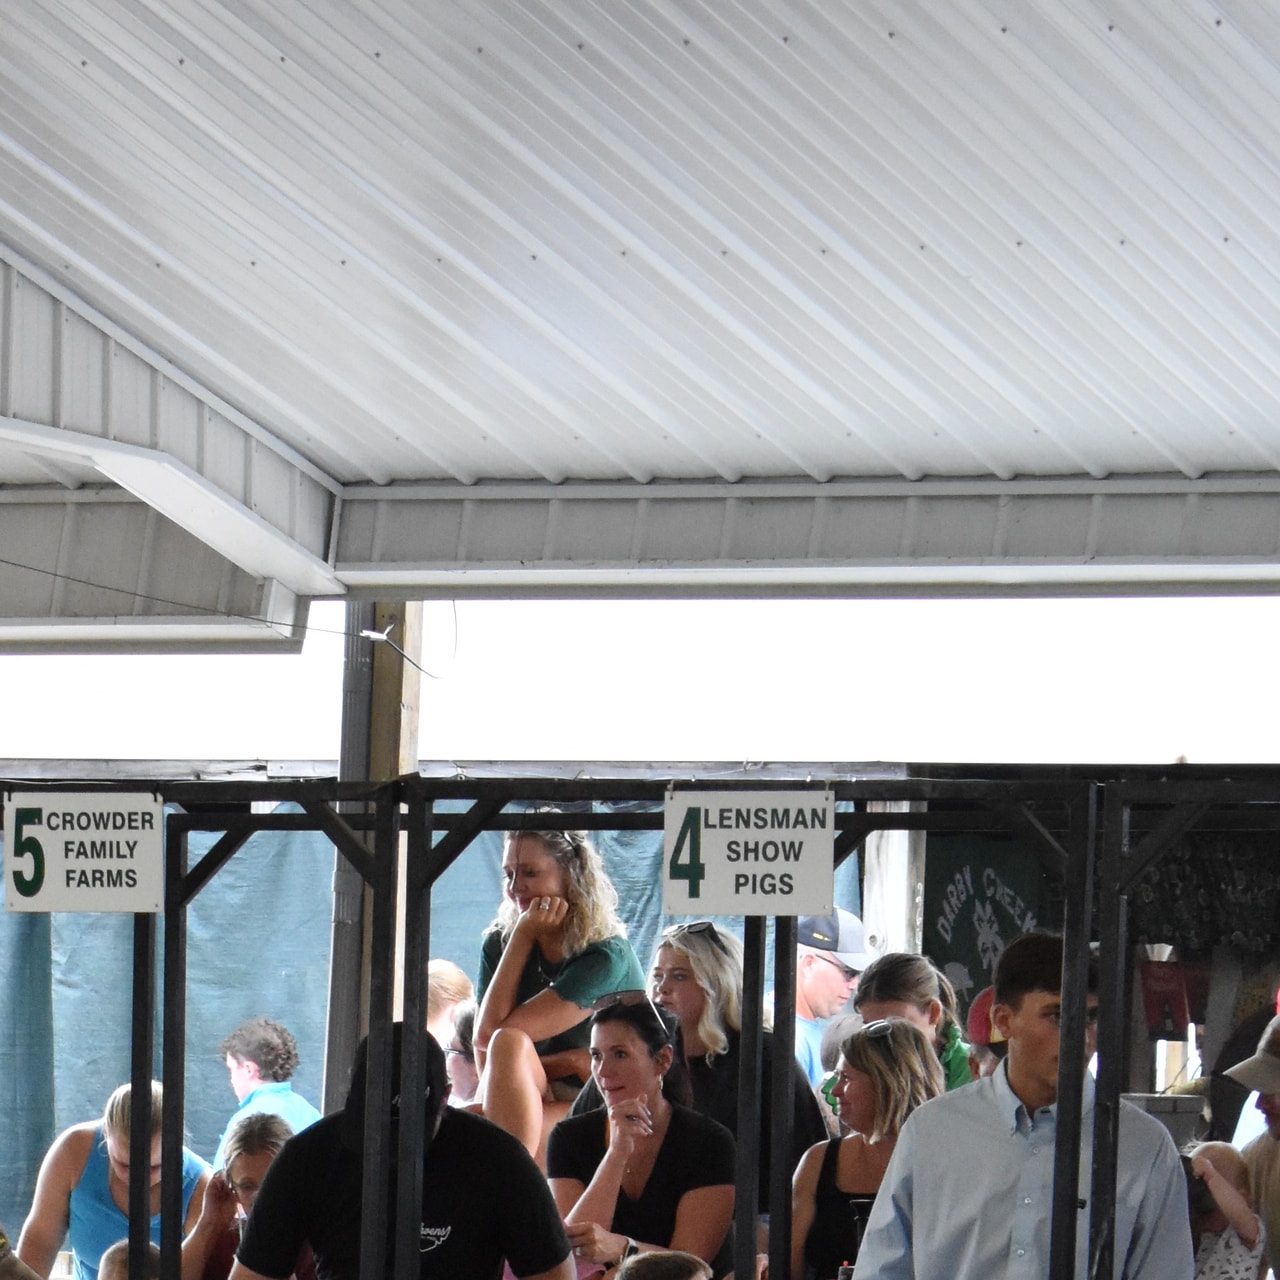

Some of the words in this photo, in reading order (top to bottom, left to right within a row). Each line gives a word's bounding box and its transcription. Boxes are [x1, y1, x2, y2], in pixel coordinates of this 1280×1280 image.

[47, 812, 154, 830] CROWDER
[704, 808, 827, 829] LENSMAN
[12, 807, 45, 898] 5
[64, 840, 138, 859] FAMILY
[669, 807, 705, 898] 4
[726, 840, 803, 862] SHOW
[65, 869, 138, 888] FARMS
[734, 873, 793, 895] PIGS
[937, 865, 974, 944] DARBY
[983, 868, 1037, 933] CREEK
